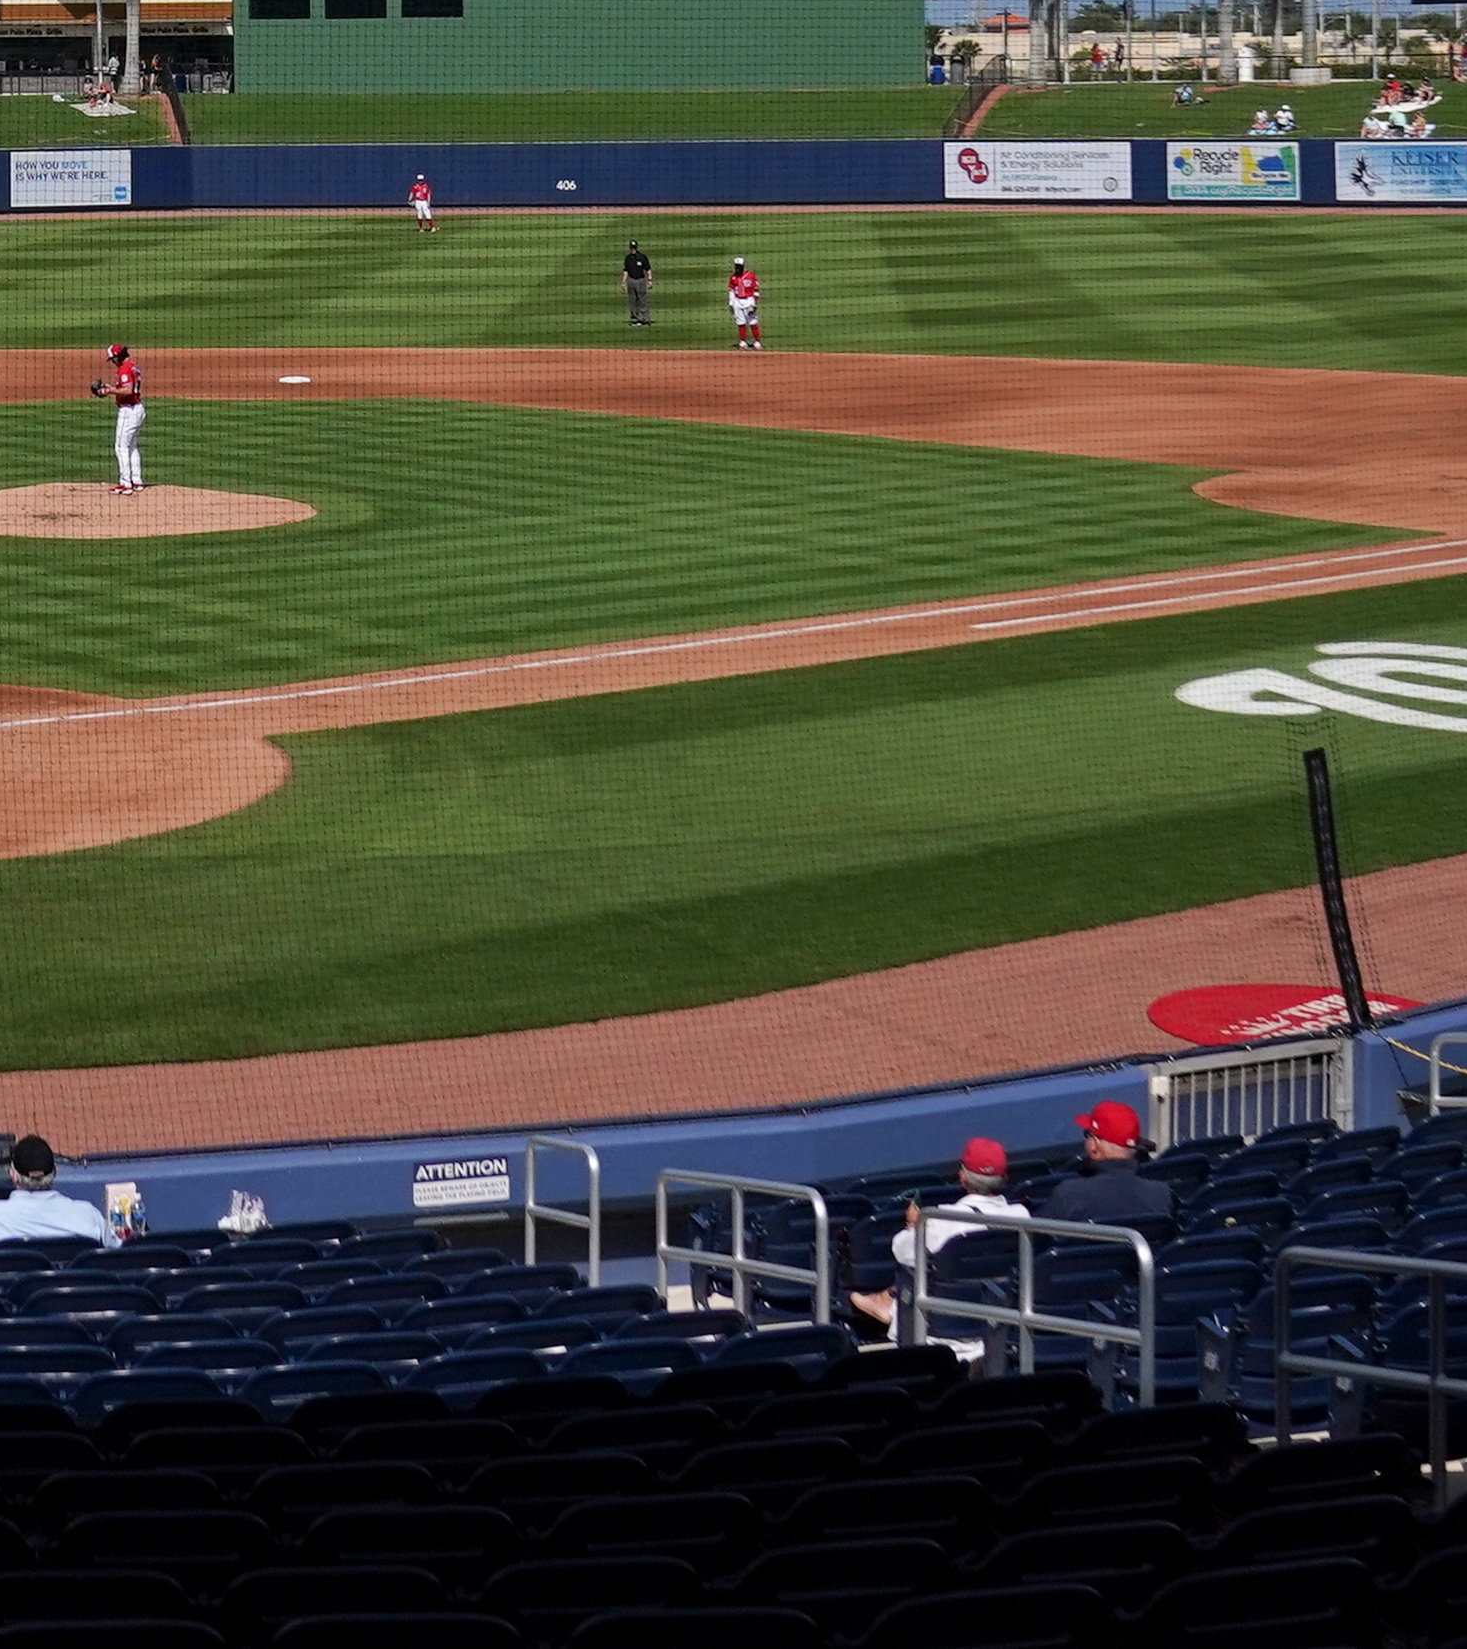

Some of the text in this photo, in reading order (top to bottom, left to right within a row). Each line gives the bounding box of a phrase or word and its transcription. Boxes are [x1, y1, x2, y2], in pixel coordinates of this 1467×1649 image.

[1192, 148, 1240, 161] Recycle
[1391, 151, 1459, 165] KEISER
[15, 160, 88, 170] HOW YOU MOVE
[1200, 161, 1233, 175] Right
[15, 172, 25, 181] IS
[27, 171, 48, 181] WHY
[51, 171, 80, 181] WE'RE
[555, 179, 578, 191] 406
[415, 1158, 507, 1181] ATTENTION
